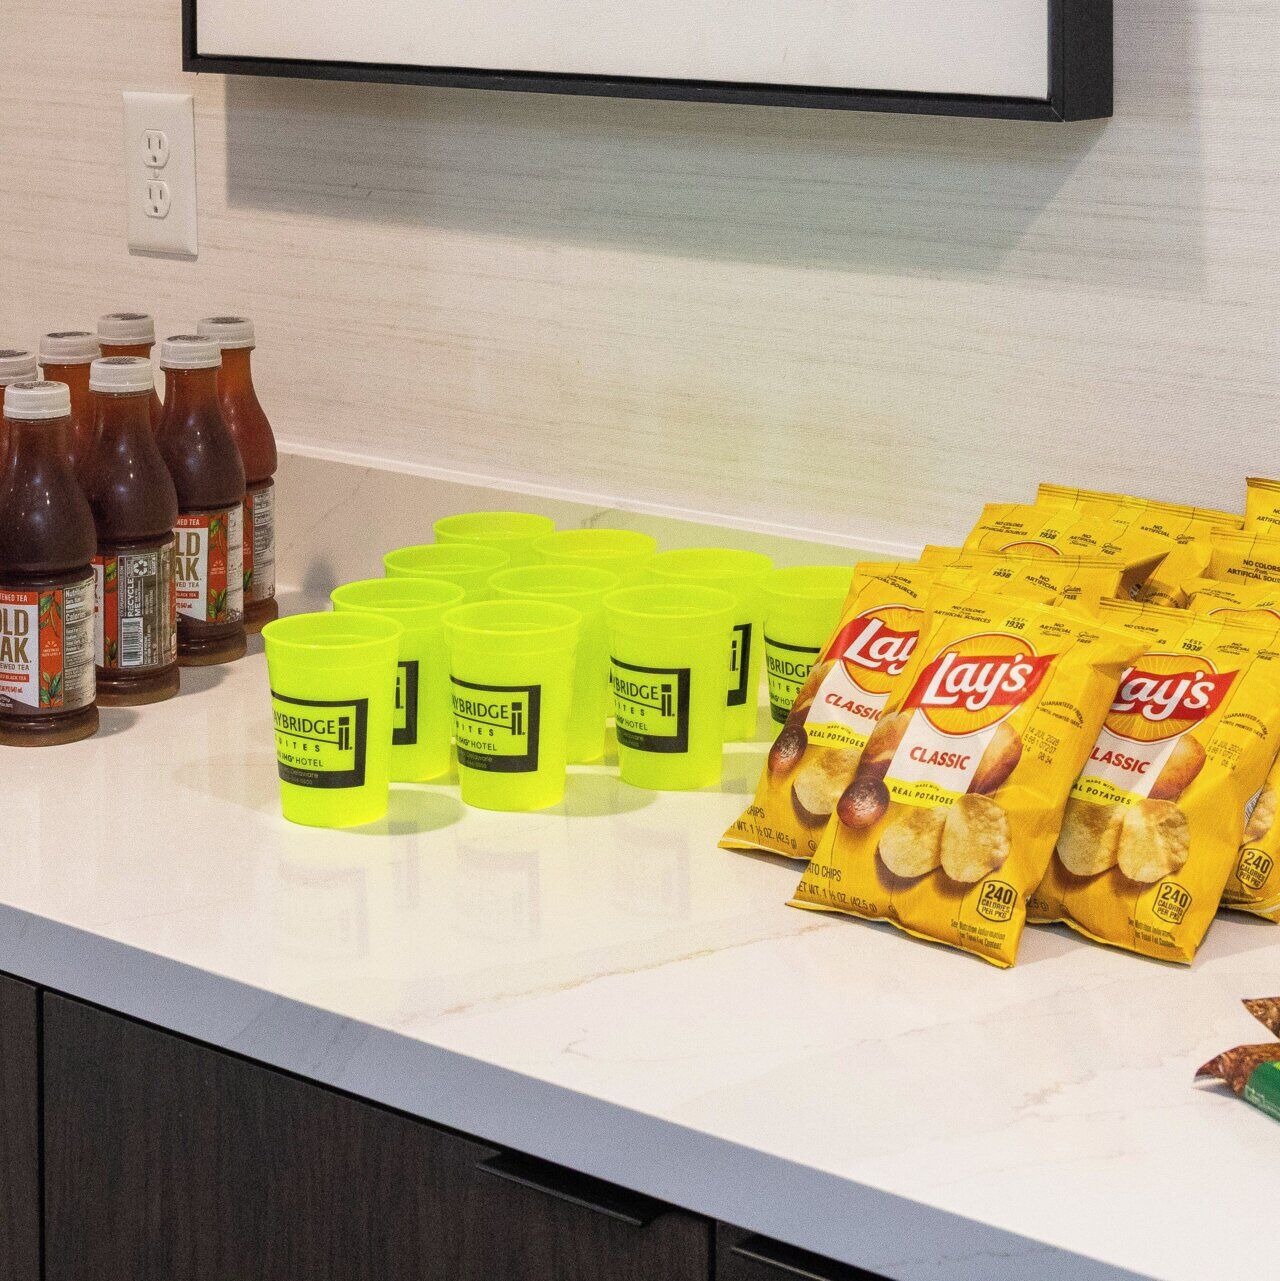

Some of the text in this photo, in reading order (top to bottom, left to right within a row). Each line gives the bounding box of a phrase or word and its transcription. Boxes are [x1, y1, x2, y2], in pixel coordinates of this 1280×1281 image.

[1039, 531, 1058, 540] 1938
[175, 531, 201, 556] LD
[175, 557, 200, 581] AK
[1243, 559, 1254, 568] NO
[992, 569, 1012, 579] 1938
[1039, 574, 1050, 582] NO
[1227, 567, 1264, 581] ARTIFICIAL
[890, 580, 918, 599] SOURCES
[1025, 575, 1058, 591] ARTIFICIAL
[127, 577, 135, 617] RECYCLE
[134, 603, 141, 617] ME
[1005, 619, 1025, 630] 1938
[843, 618, 918, 675] Lay
[1182, 642, 1202, 652] 1938
[920, 652, 1034, 711] Lay's
[1041, 700, 1074, 710] GUARANTEED
[625, 720, 648, 731] HOTEL
[471, 740, 497, 751] HOTEL
[809, 730, 865, 748] REAL POTATOES
[295, 757, 323, 767] HOTEL
[910, 746, 971, 770] CLASSIC
[1090, 745, 1151, 775] LASSIC
[892, 786, 954, 806] REAL POTATOES
[1086, 786, 1132, 806] POTATOES
[1244, 851, 1270, 874] 240
[822, 866, 841, 881] CHIPS
[1239, 871, 1251, 881] PER
[985, 883, 1013, 905] 240
[1162, 885, 1189, 908] 240
[981, 899, 1010, 913] CALORIES
[981, 906, 993, 915] PER
[1157, 907, 1169, 915] PER
